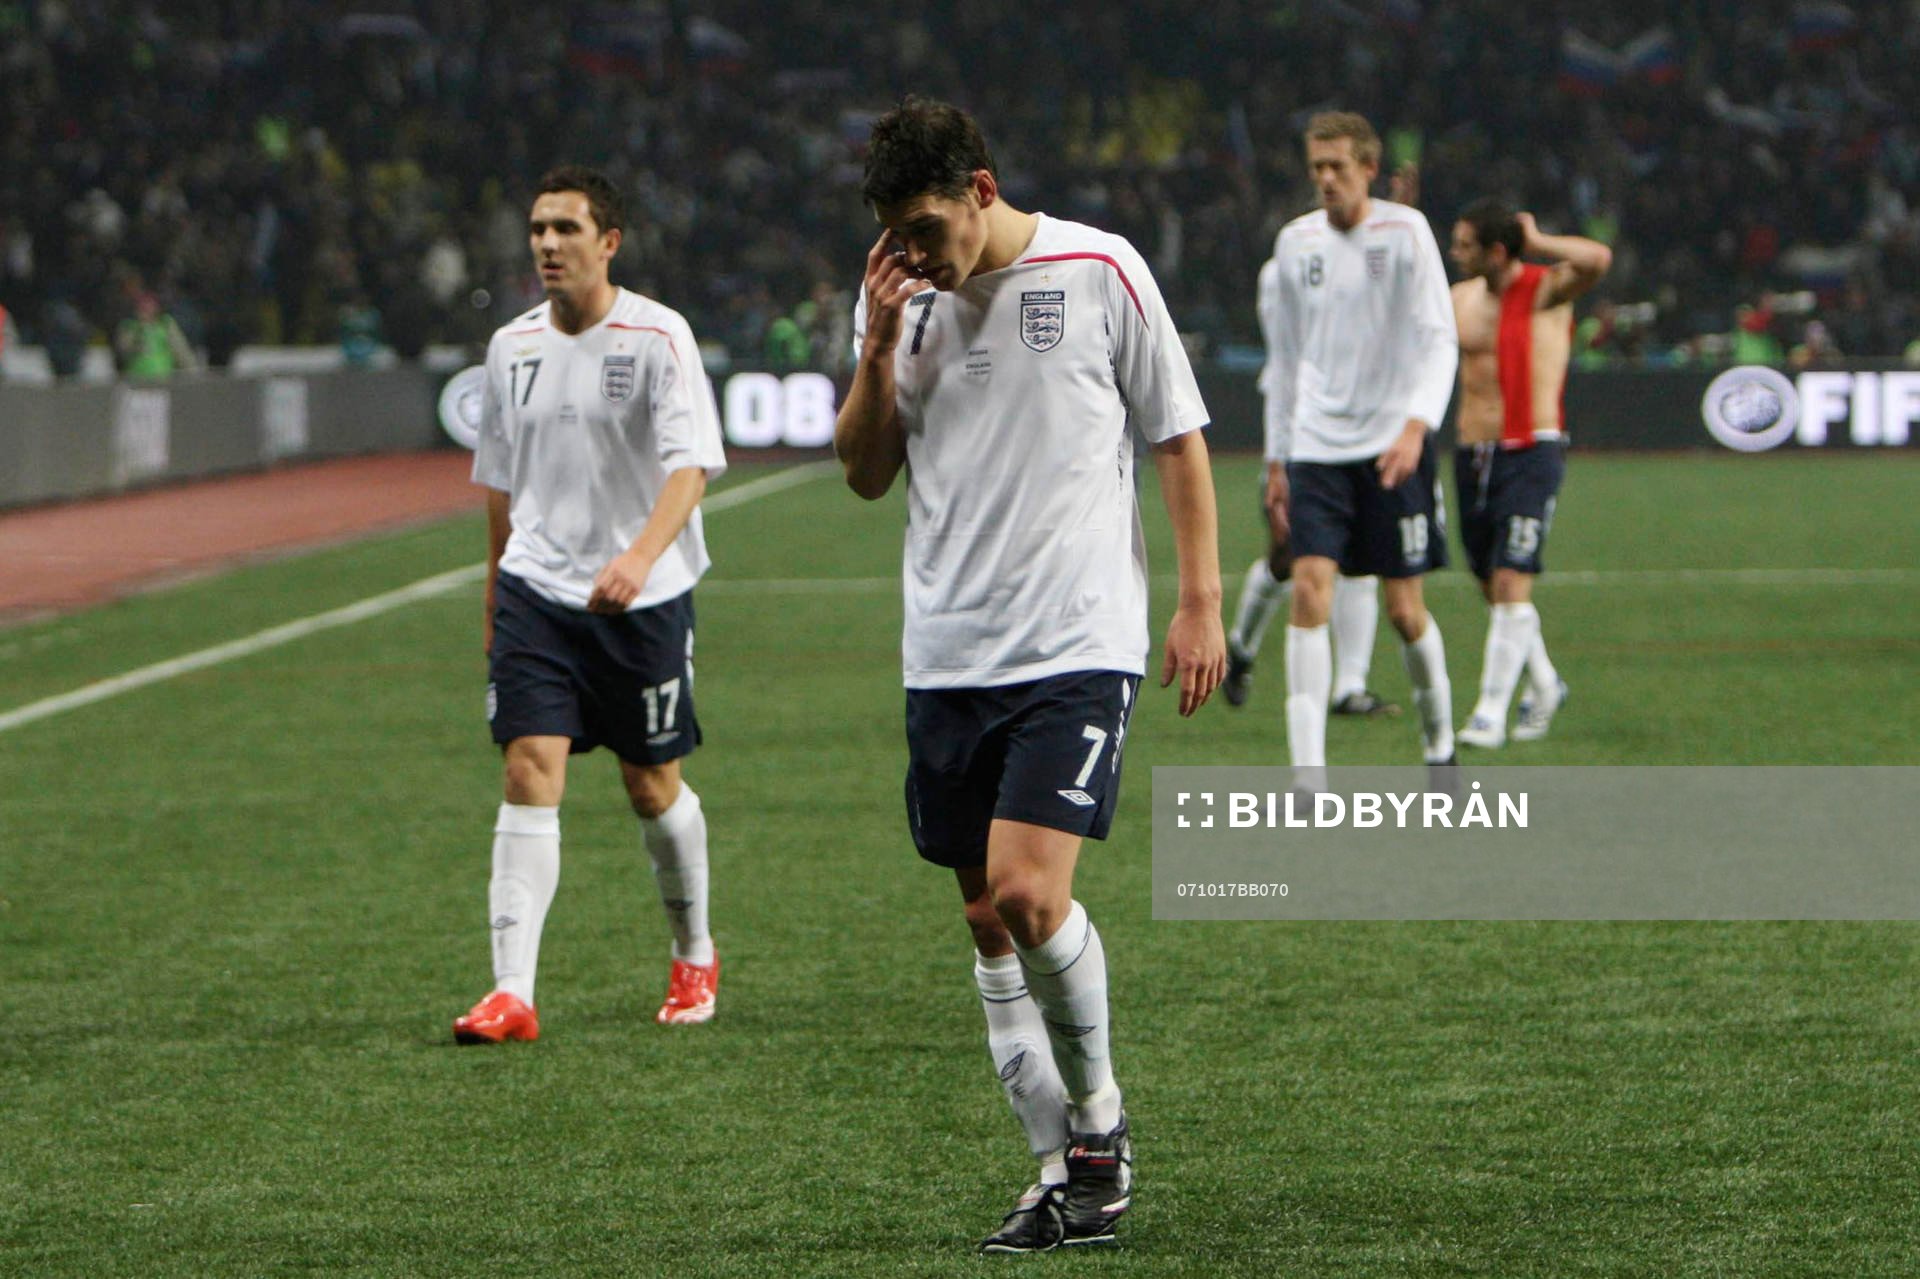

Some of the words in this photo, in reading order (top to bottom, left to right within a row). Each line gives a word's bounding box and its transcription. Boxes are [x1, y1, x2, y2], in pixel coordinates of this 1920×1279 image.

[910, 291, 936, 356] 7
[1024, 292, 1062, 300] ENGLAND
[510, 358, 543, 407] 17
[724, 372, 837, 447] 08
[641, 677, 681, 733] 17
[1074, 724, 1108, 788] 7
